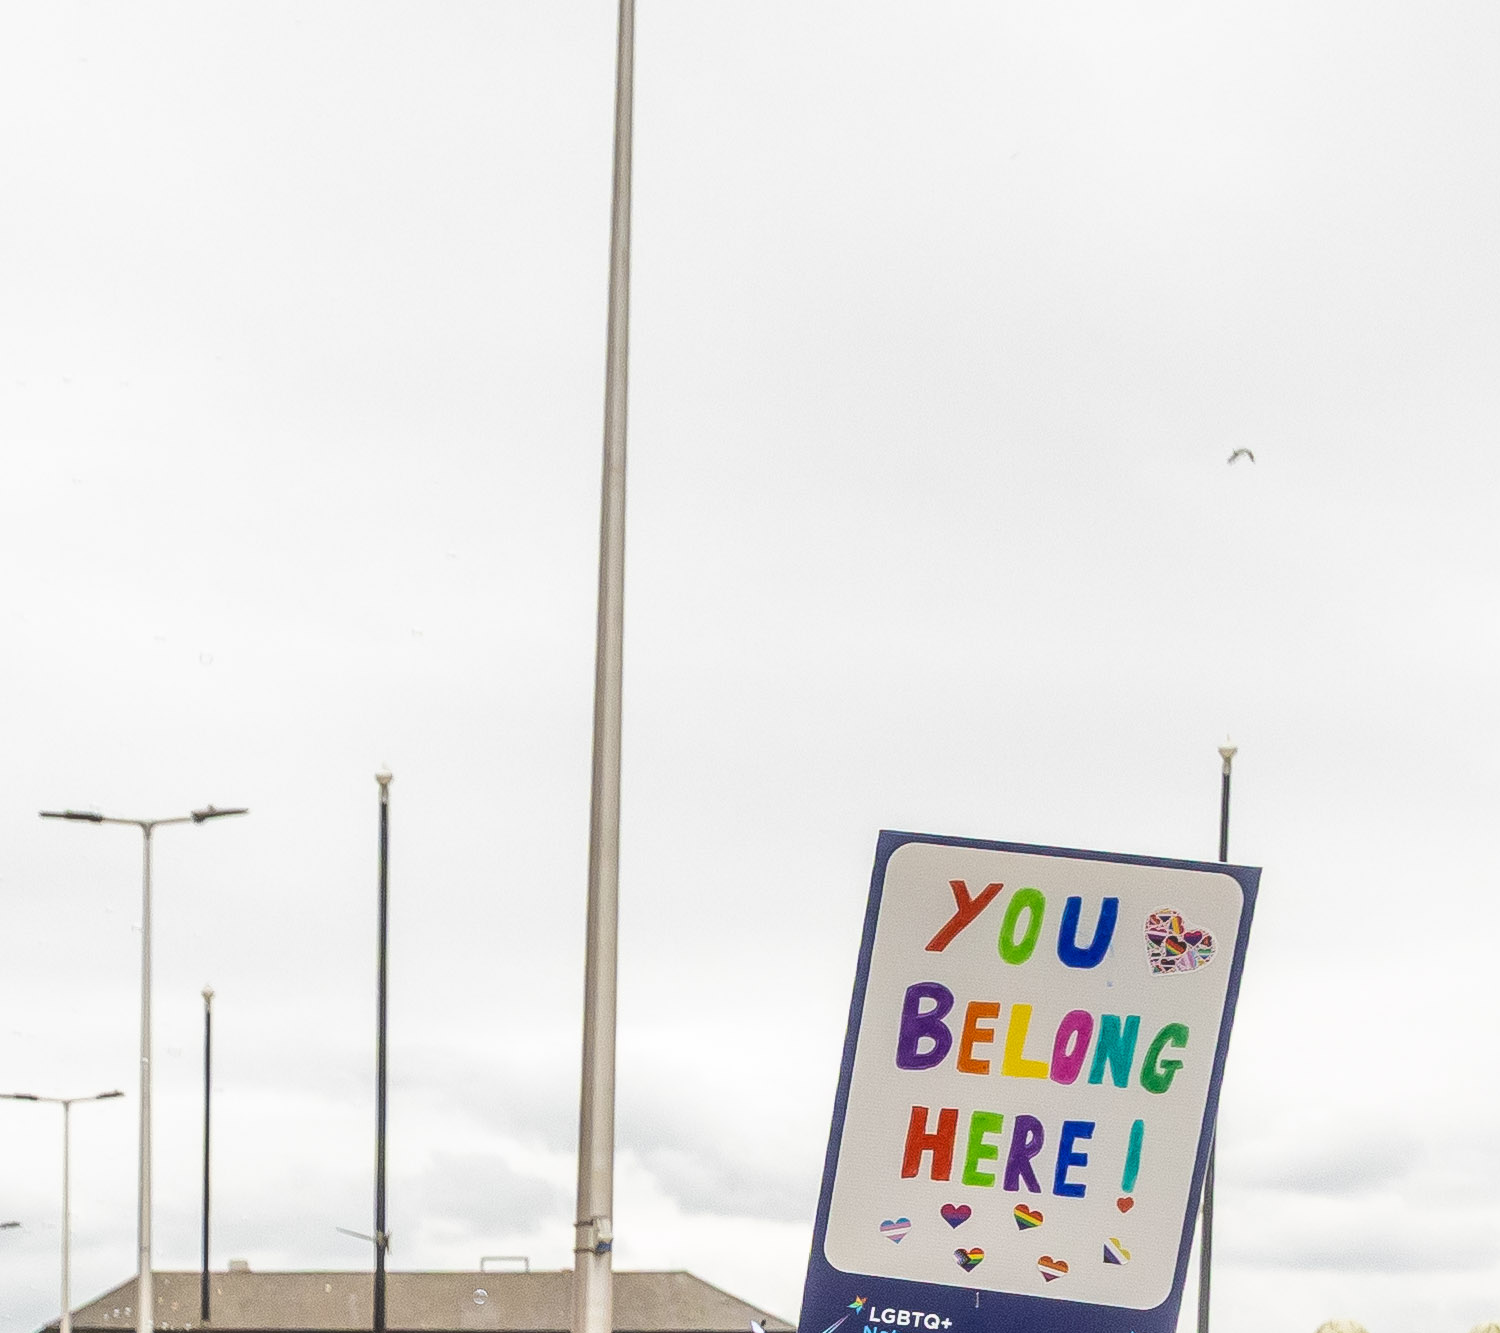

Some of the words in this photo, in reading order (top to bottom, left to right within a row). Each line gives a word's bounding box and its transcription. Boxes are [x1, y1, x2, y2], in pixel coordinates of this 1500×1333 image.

[923, 878, 1120, 970] YOU
[894, 981, 1191, 1095] BELONG
[868, 1304, 954, 1332] LGBTQ+
